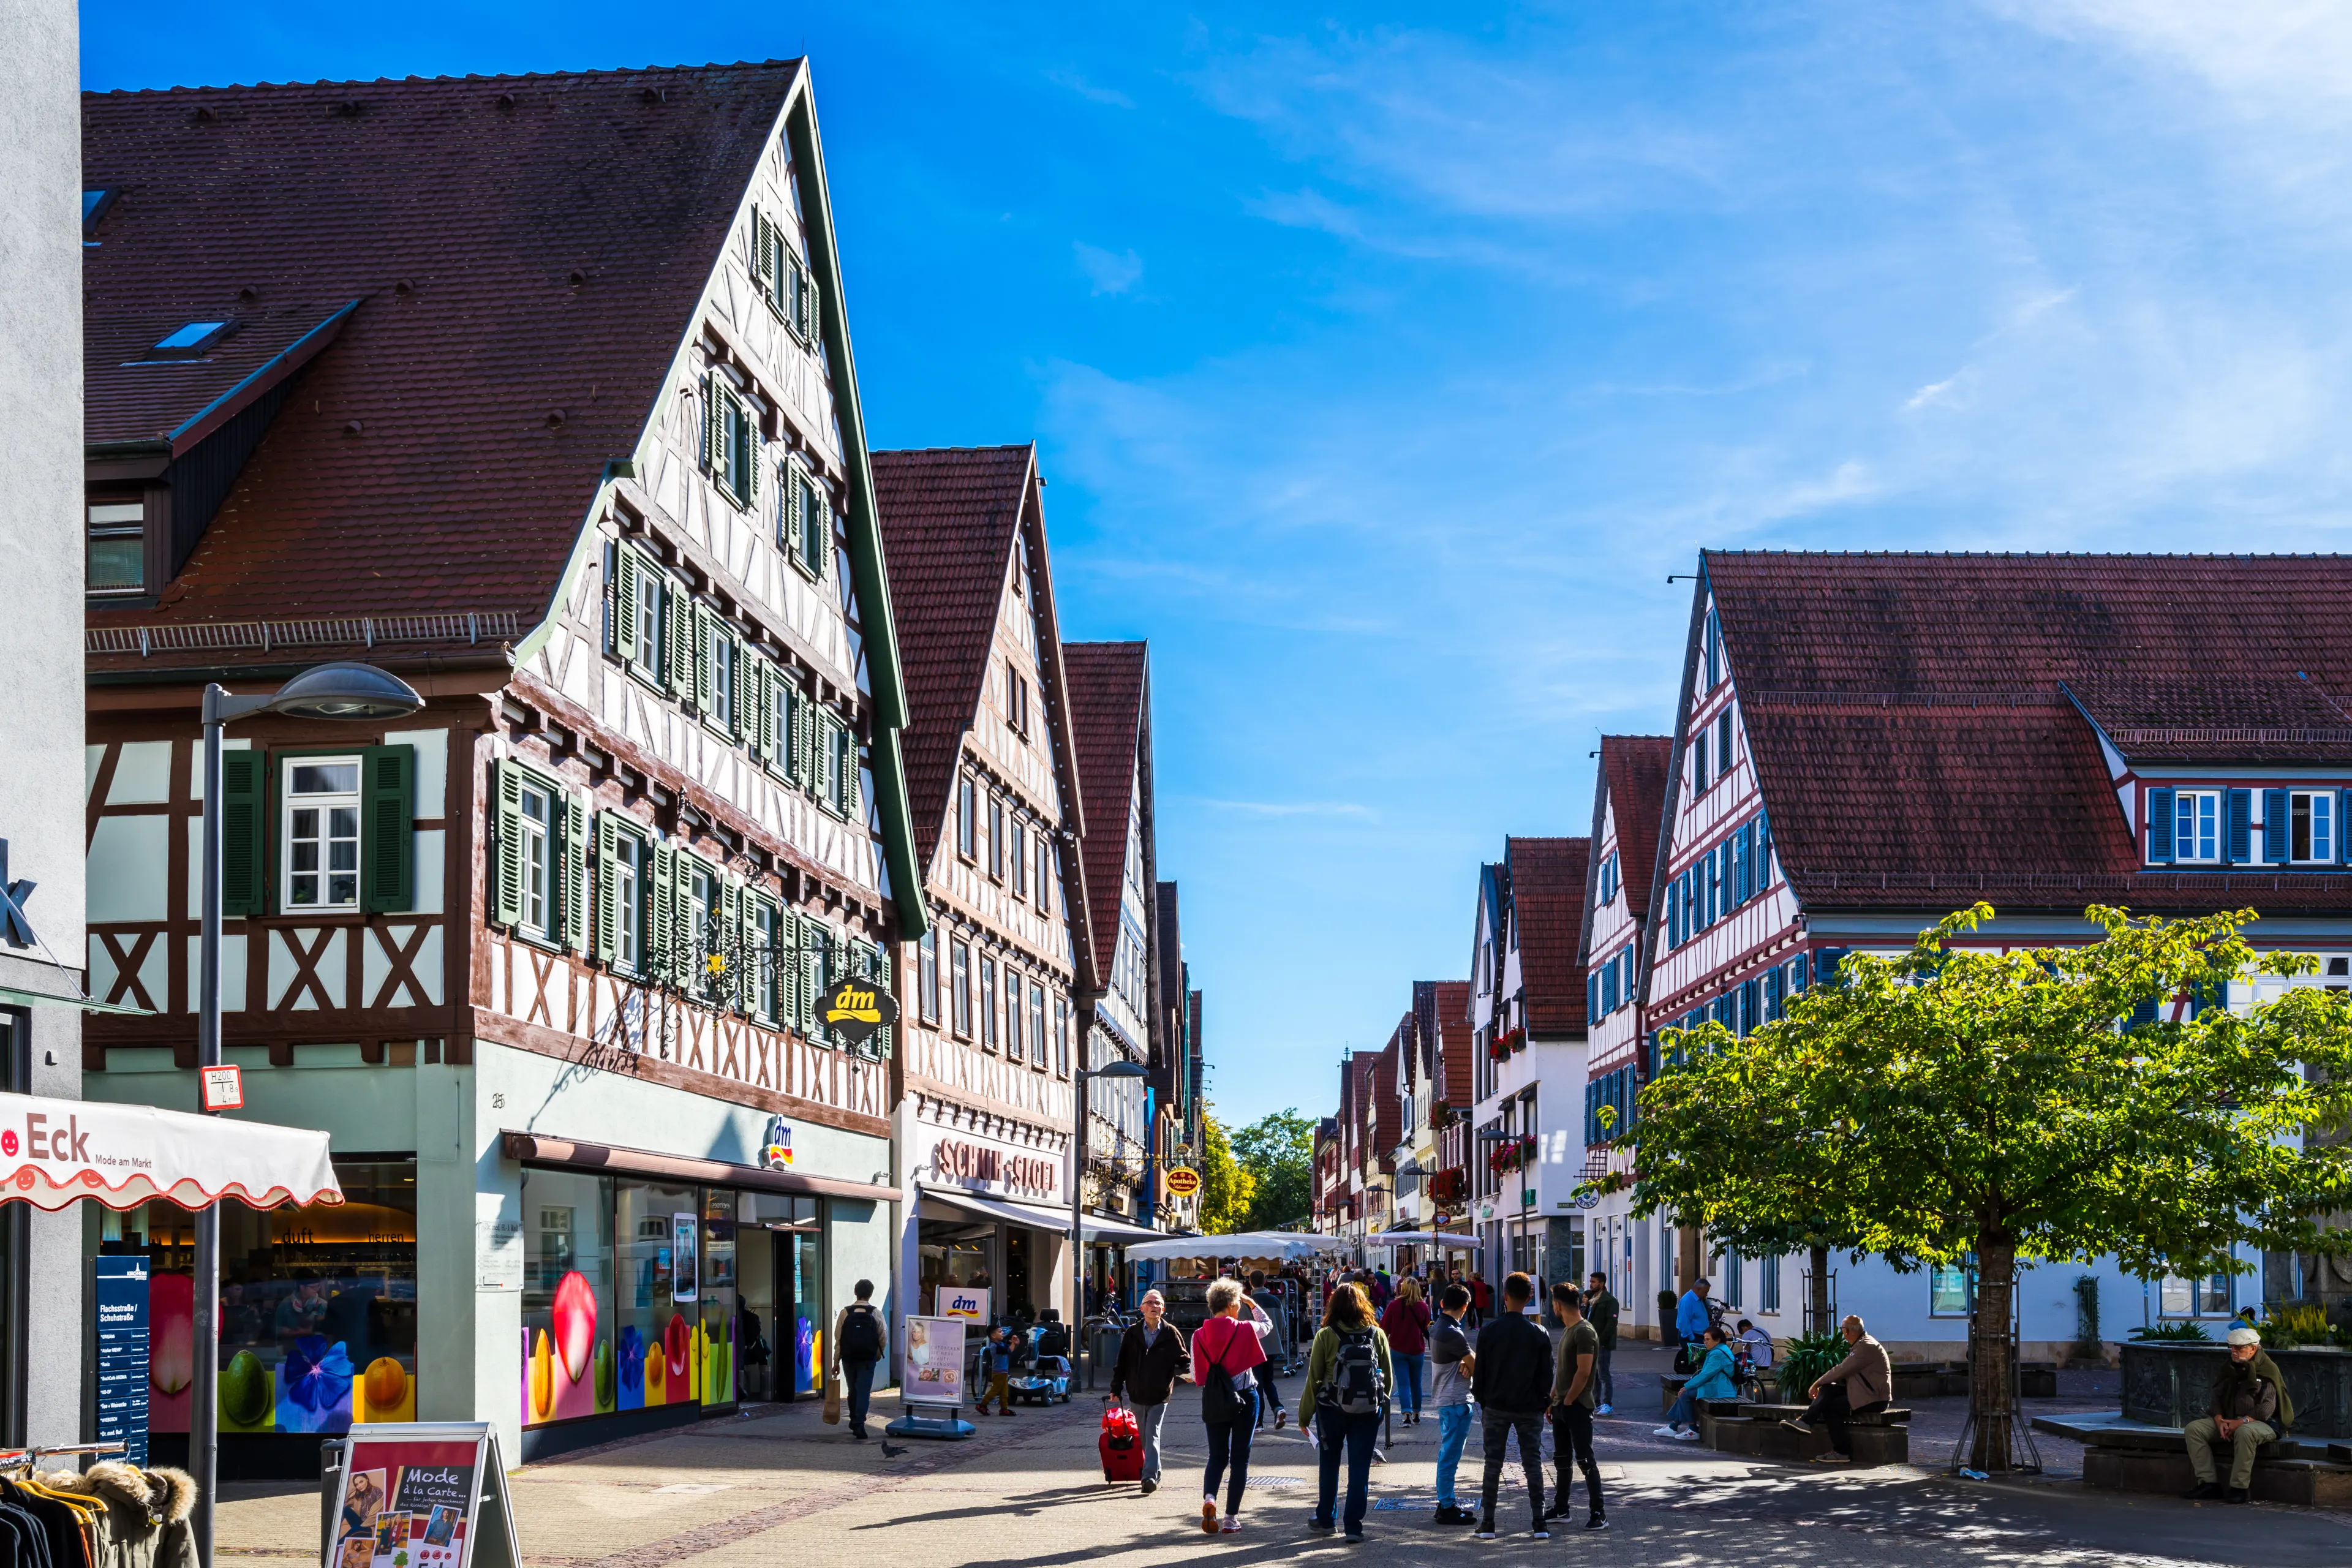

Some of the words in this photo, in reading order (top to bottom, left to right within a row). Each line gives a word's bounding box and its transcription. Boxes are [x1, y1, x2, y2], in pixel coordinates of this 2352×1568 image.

[835, 984, 875, 1009] dm
[26, 1112, 91, 1163] Eck
[774, 1117, 791, 1147] dm
[96, 1154, 116, 1166] Mode
[132, 1157, 152, 1169] Markt
[1577, 1196, 1597, 1207] REISEN
[283, 1227, 314, 1243] duft
[368, 1229, 404, 1243] herren
[100, 1304, 134, 1313] Flachsstraße
[952, 1295, 976, 1310] dm
[100, 1313, 134, 1322] Schuhstraße
[406, 1467, 459, 1485] Mode
[404, 1483, 410, 1494] à
[413, 1485, 424, 1495] la
